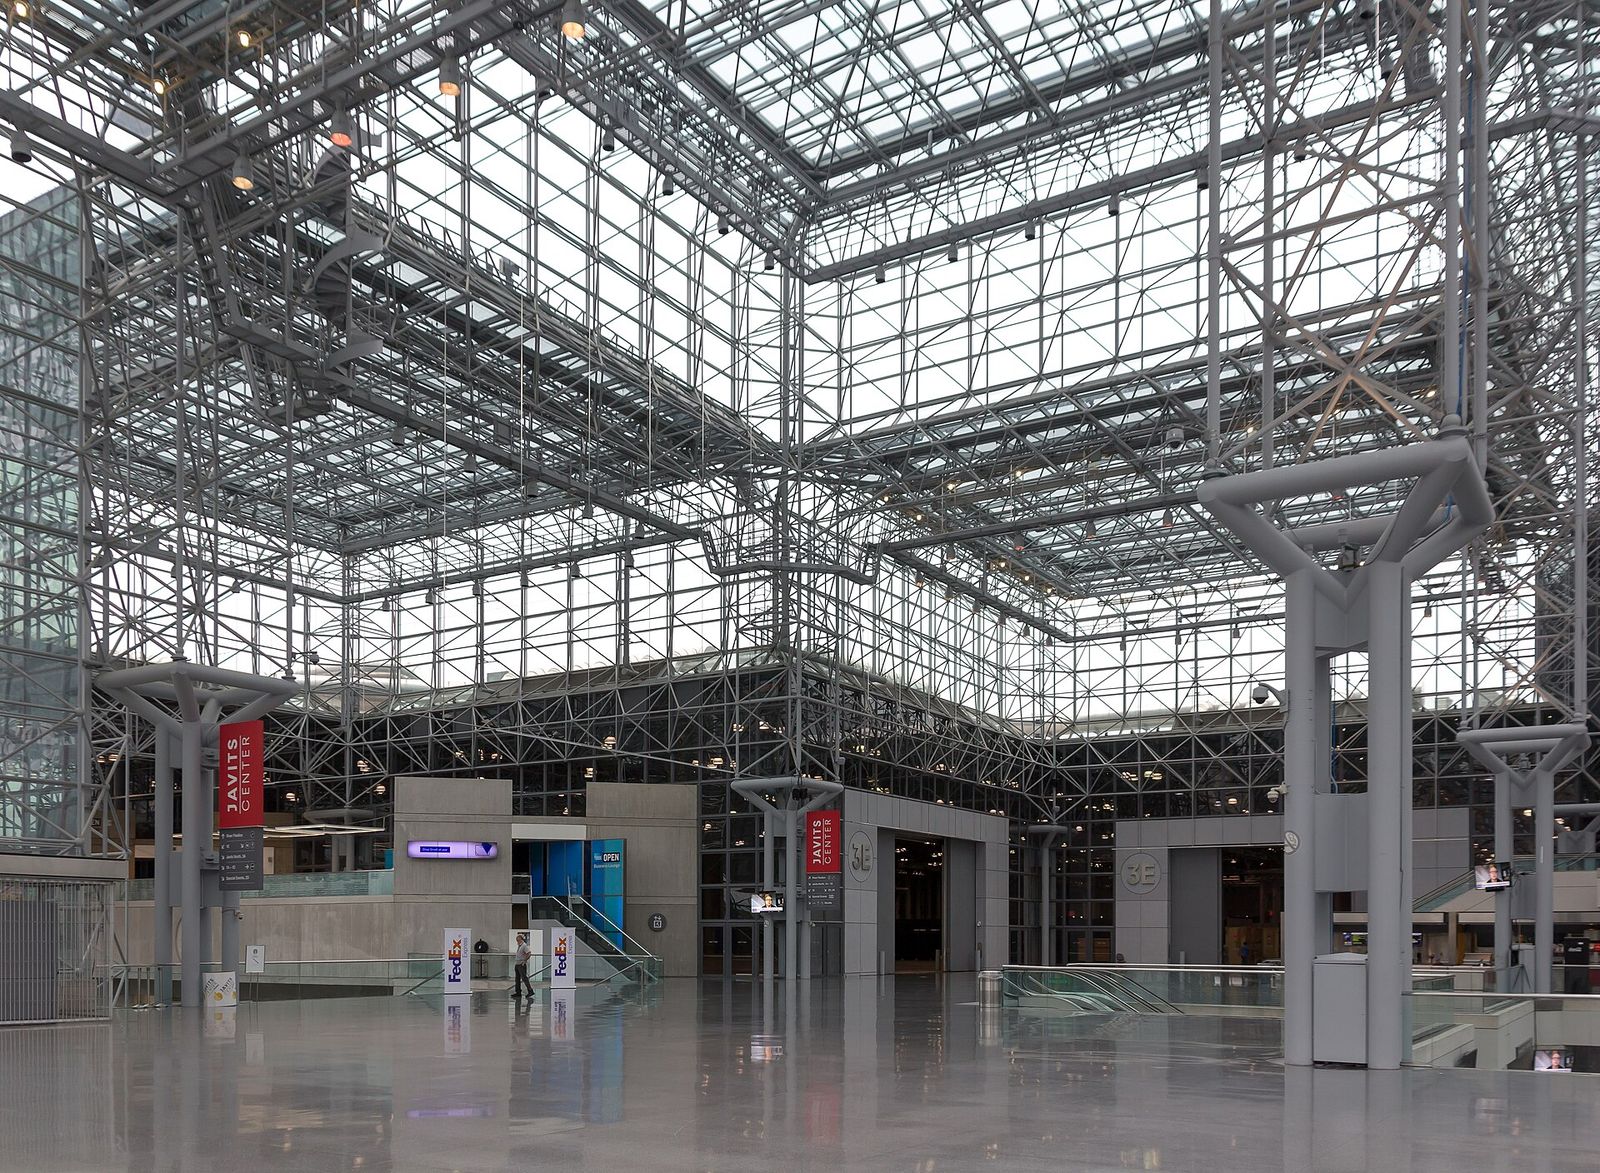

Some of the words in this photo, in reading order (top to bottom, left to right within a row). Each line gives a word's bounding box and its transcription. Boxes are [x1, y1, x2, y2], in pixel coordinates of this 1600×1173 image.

[227, 739, 238, 812] JAVITS
[241, 736, 250, 811] CENTER
[603, 853, 620, 862] OPEN
[813, 820, 822, 864] JAVITS
[824, 819, 832, 864] CENTER
[851, 843, 871, 871] 3E
[1126, 864, 1155, 885] 3E
[448, 939, 461, 982] FedEx
[555, 937, 566, 976] FedEx
